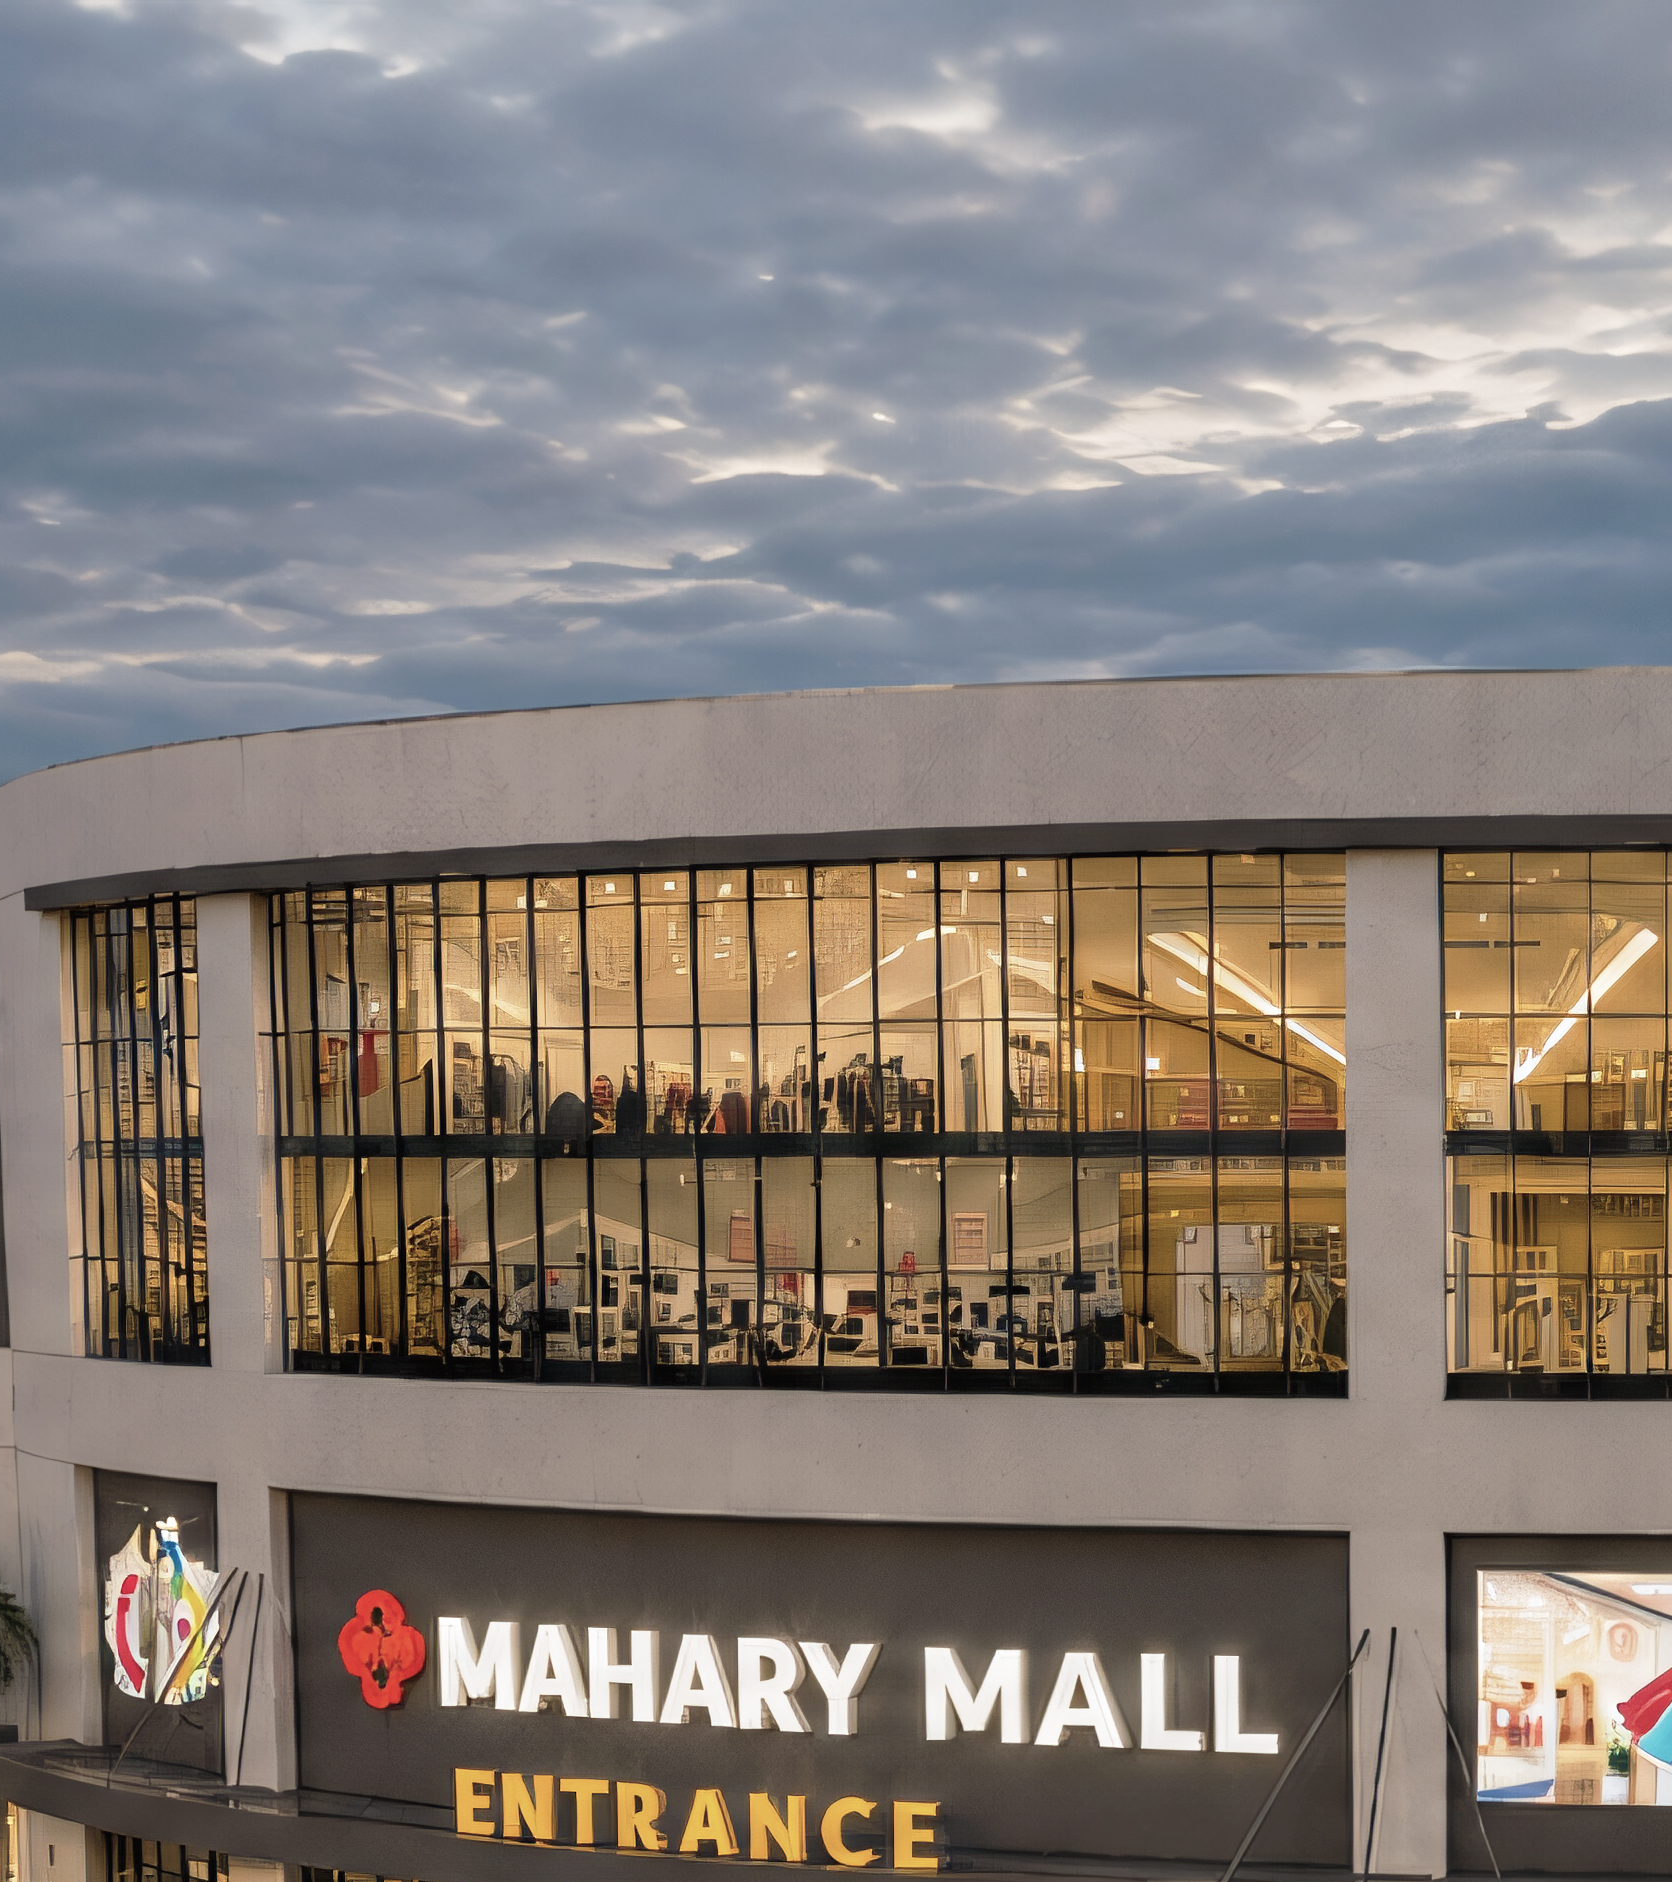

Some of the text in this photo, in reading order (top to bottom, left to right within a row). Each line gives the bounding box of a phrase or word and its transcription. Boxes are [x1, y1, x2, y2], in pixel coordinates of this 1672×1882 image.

[437, 1616, 1279, 1754] MAHARY MALL
[454, 1767, 941, 1869] ENTRANCE
